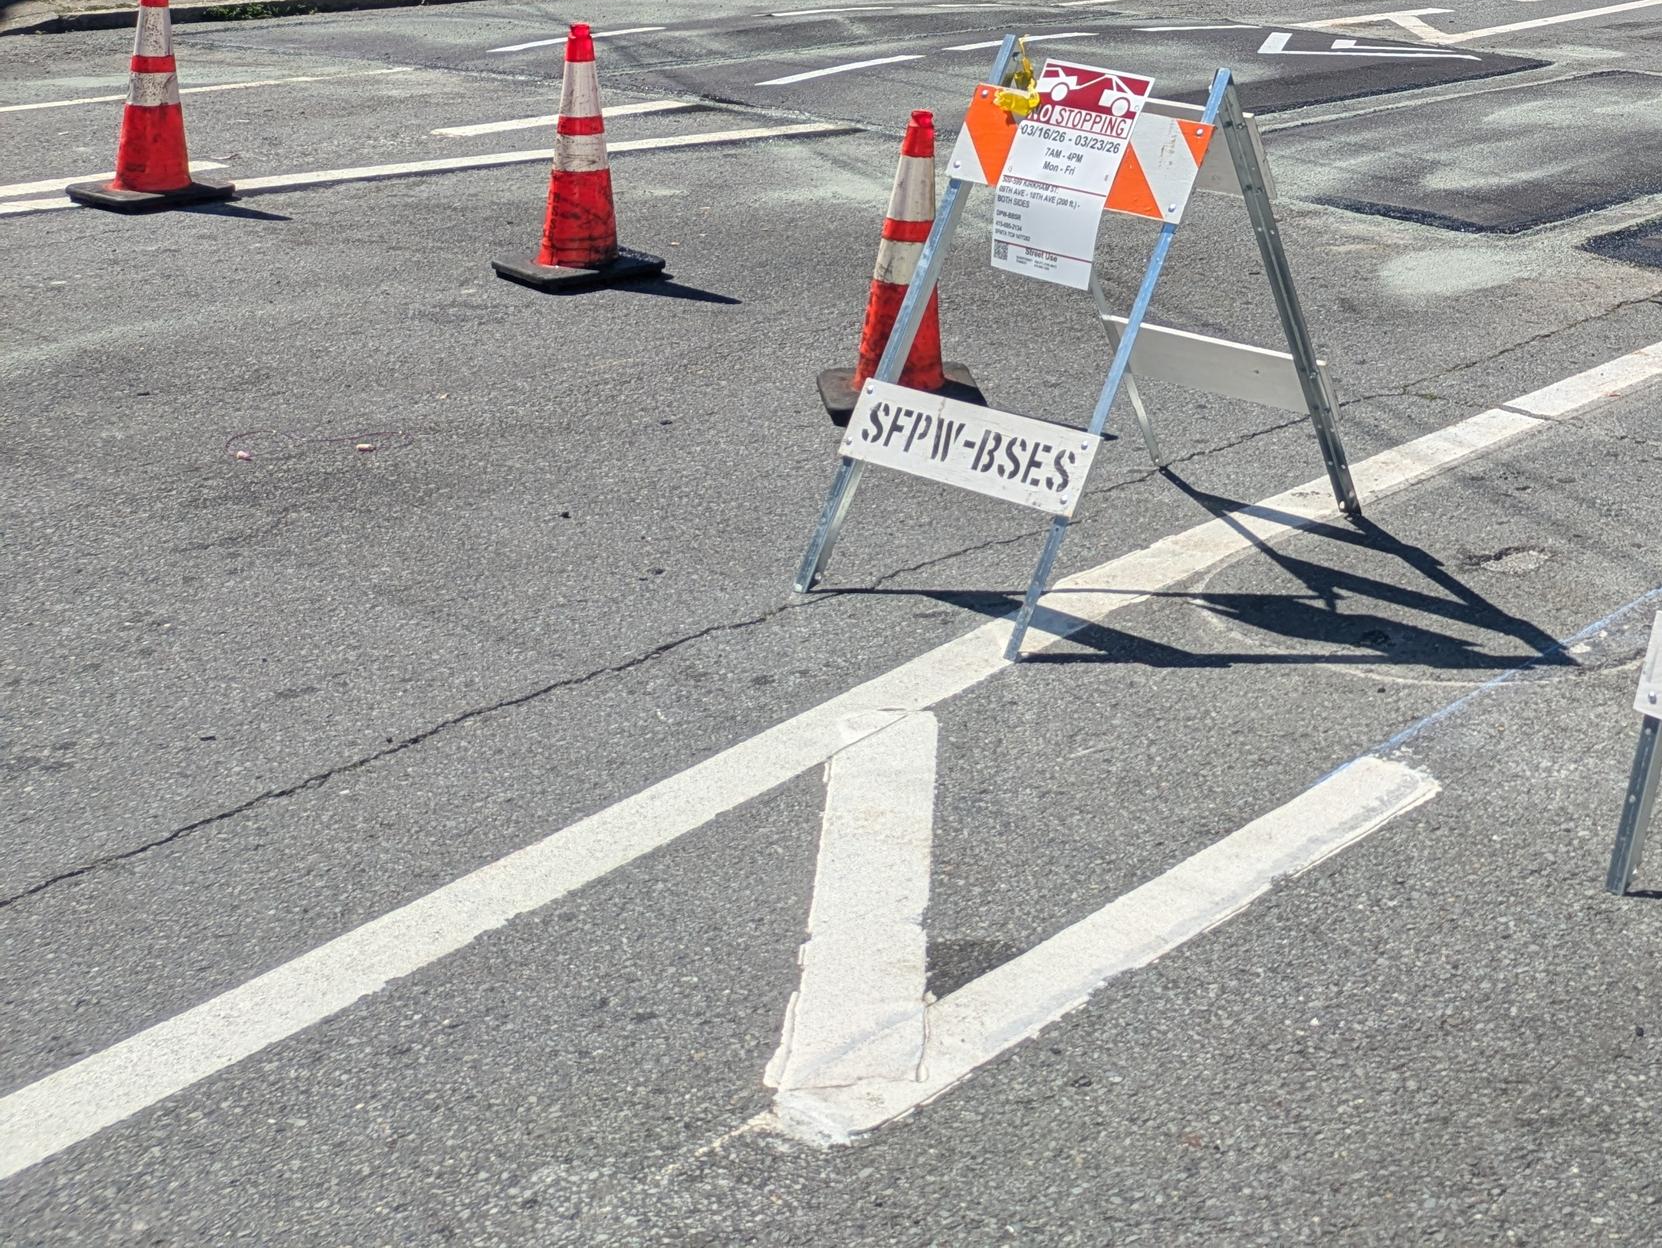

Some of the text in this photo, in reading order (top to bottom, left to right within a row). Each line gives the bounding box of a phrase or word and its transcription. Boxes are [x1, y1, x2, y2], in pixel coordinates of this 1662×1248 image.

[1028, 104, 1126, 136] NO STOPPING
[1021, 124, 1066, 143] 03/16/26
[1075, 135, 1121, 154] 03/23/26
[1045, 147, 1062, 159] 7AM
[1067, 152, 1083, 163] 4PM
[1043, 161, 1058, 172] Mon
[1064, 165, 1075, 175] Fri
[997, 195, 1030, 208] BOTH SIDES
[1043, 195, 1055, 204] AVE
[861, 402, 1076, 492] SFPW-BSES
